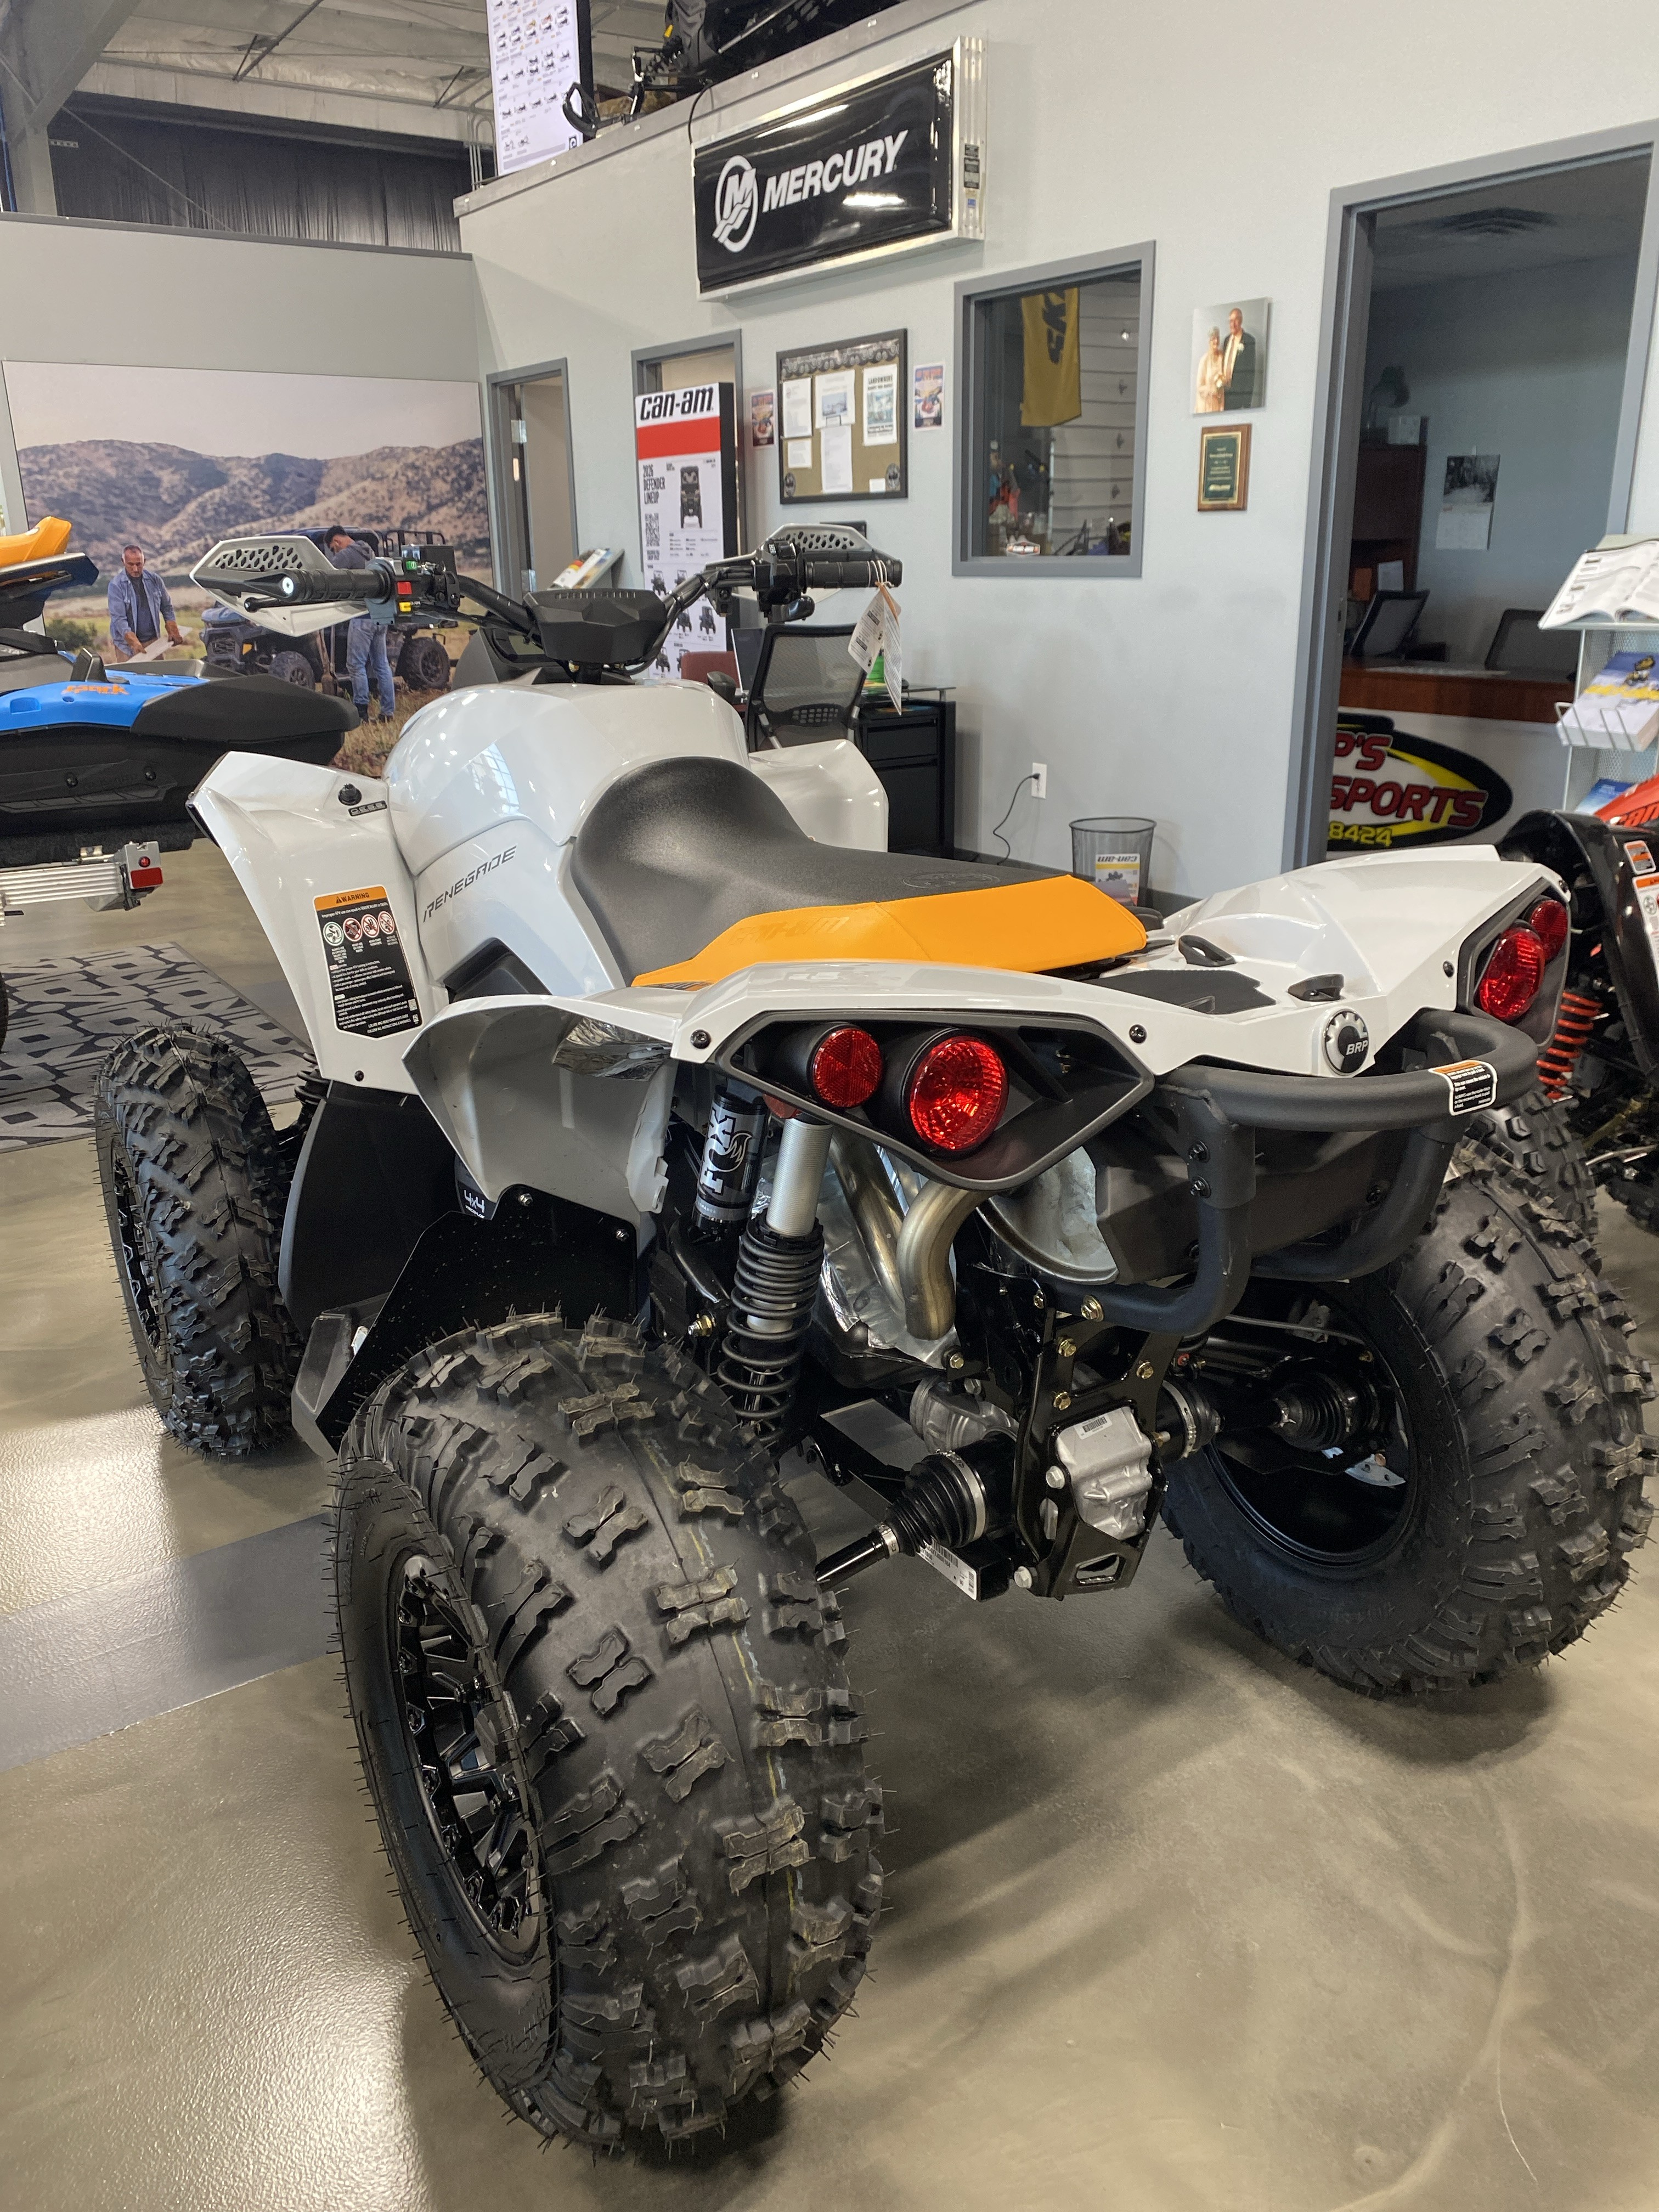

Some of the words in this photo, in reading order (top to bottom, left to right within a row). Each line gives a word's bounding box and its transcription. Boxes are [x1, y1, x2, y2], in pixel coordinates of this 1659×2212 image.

[762, 129, 909, 213] MERCURY
[640, 386, 714, 421] can-am
[644, 476, 665, 491] DEFENDER
[644, 491, 659, 504] LINEUP
[423, 845, 517, 923] RENEGADE
[341, 892, 370, 902] WARNING
[1346, 1040, 1369, 1055] BRP
[699, 1107, 751, 1195] FOX
[464, 1189, 486, 1214] 4x4
